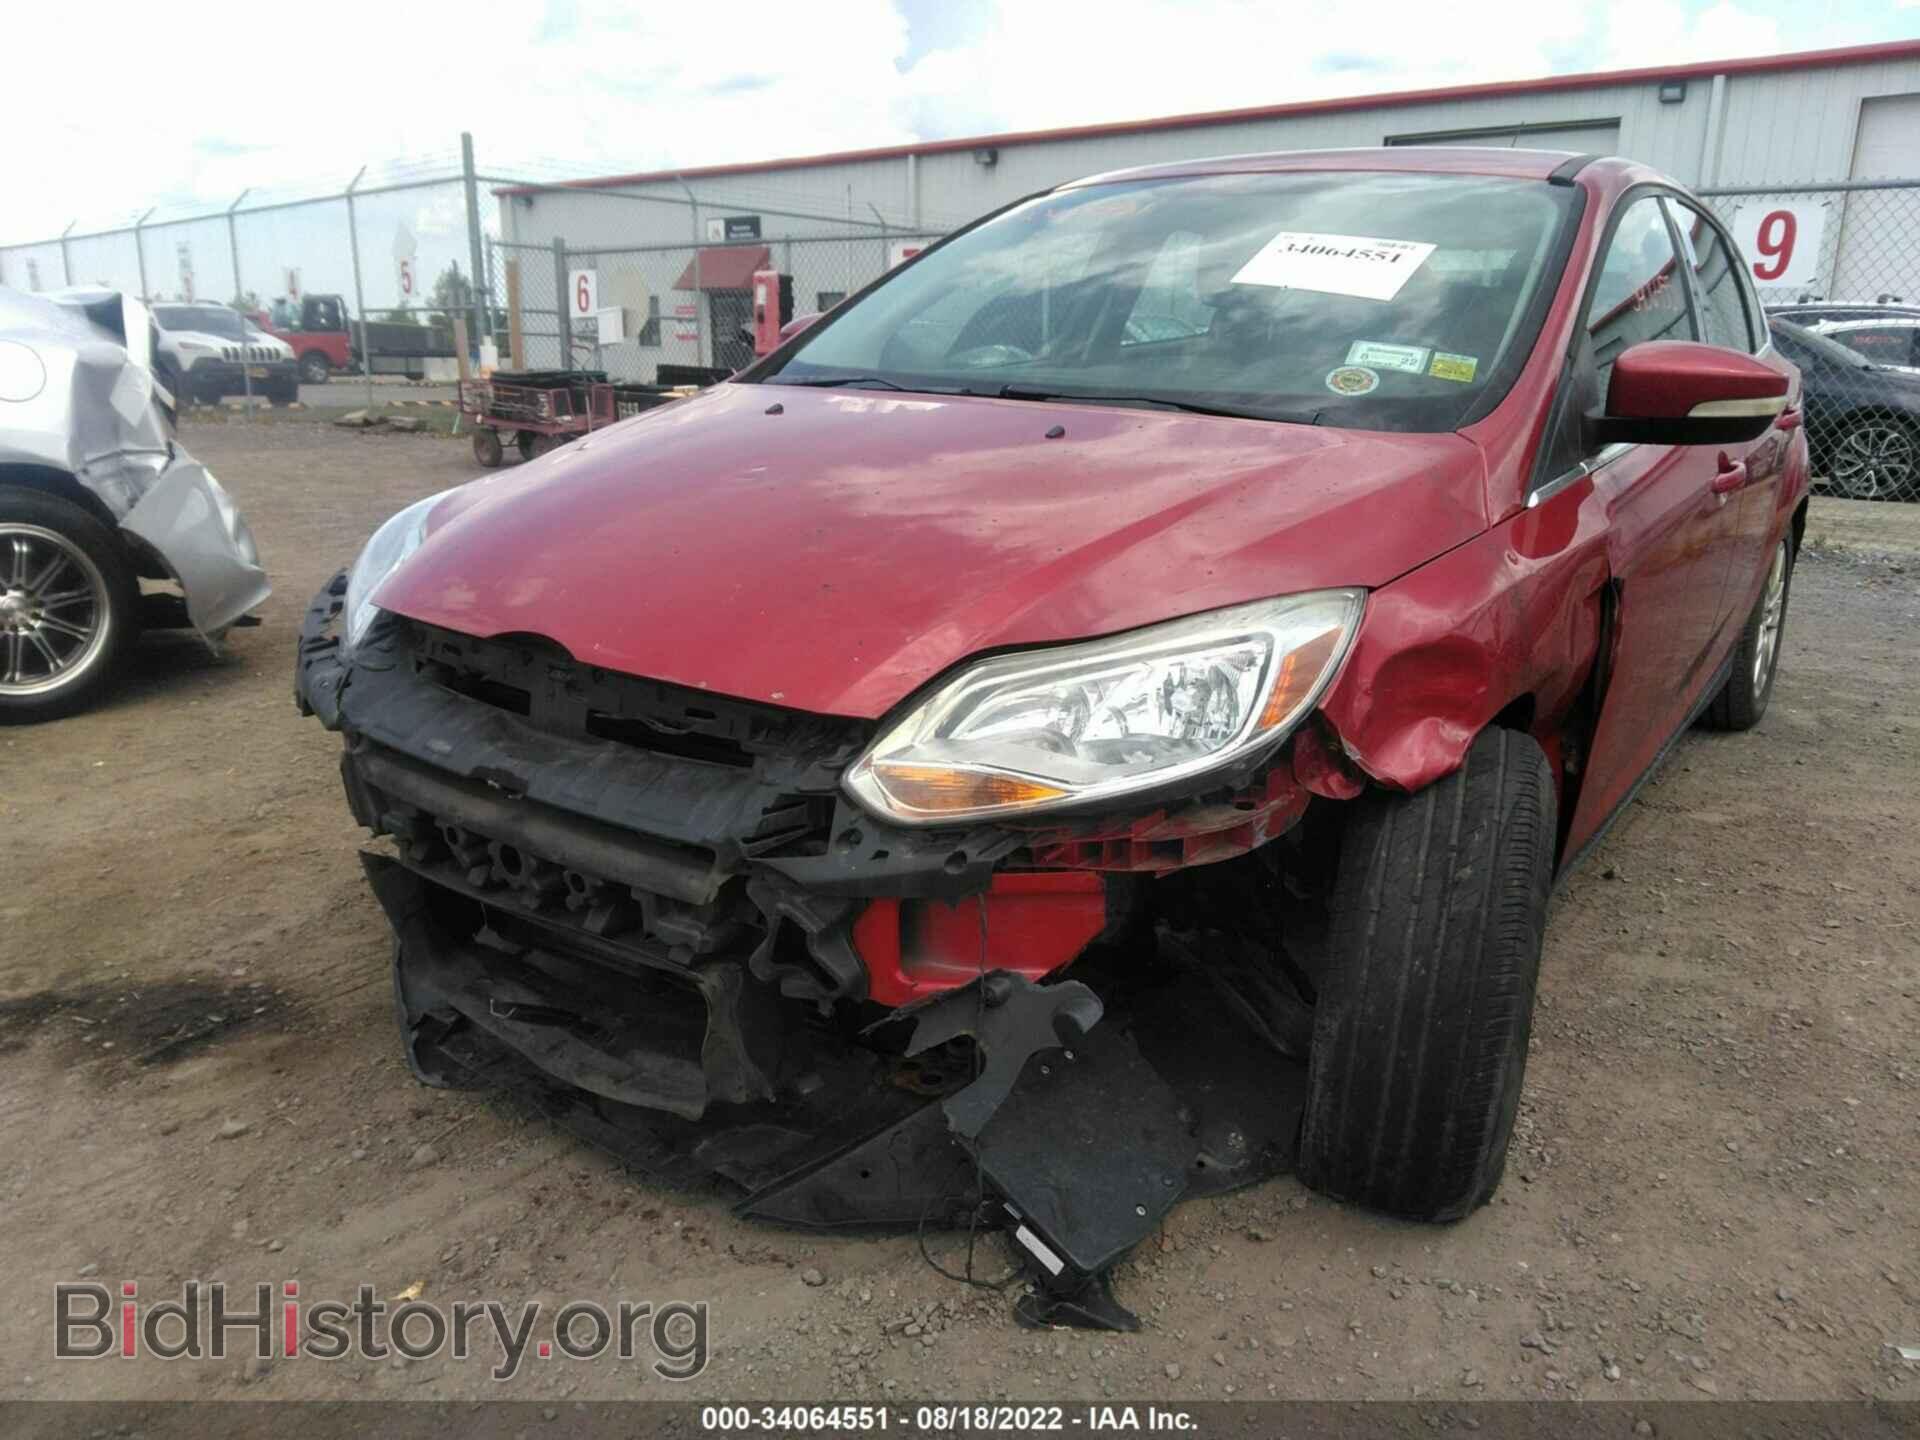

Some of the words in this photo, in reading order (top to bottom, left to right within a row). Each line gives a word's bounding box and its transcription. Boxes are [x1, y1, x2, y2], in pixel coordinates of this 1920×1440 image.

[1753, 209, 1798, 281] 9
[400, 260, 412, 295] 5
[577, 274, 590, 313] 6
